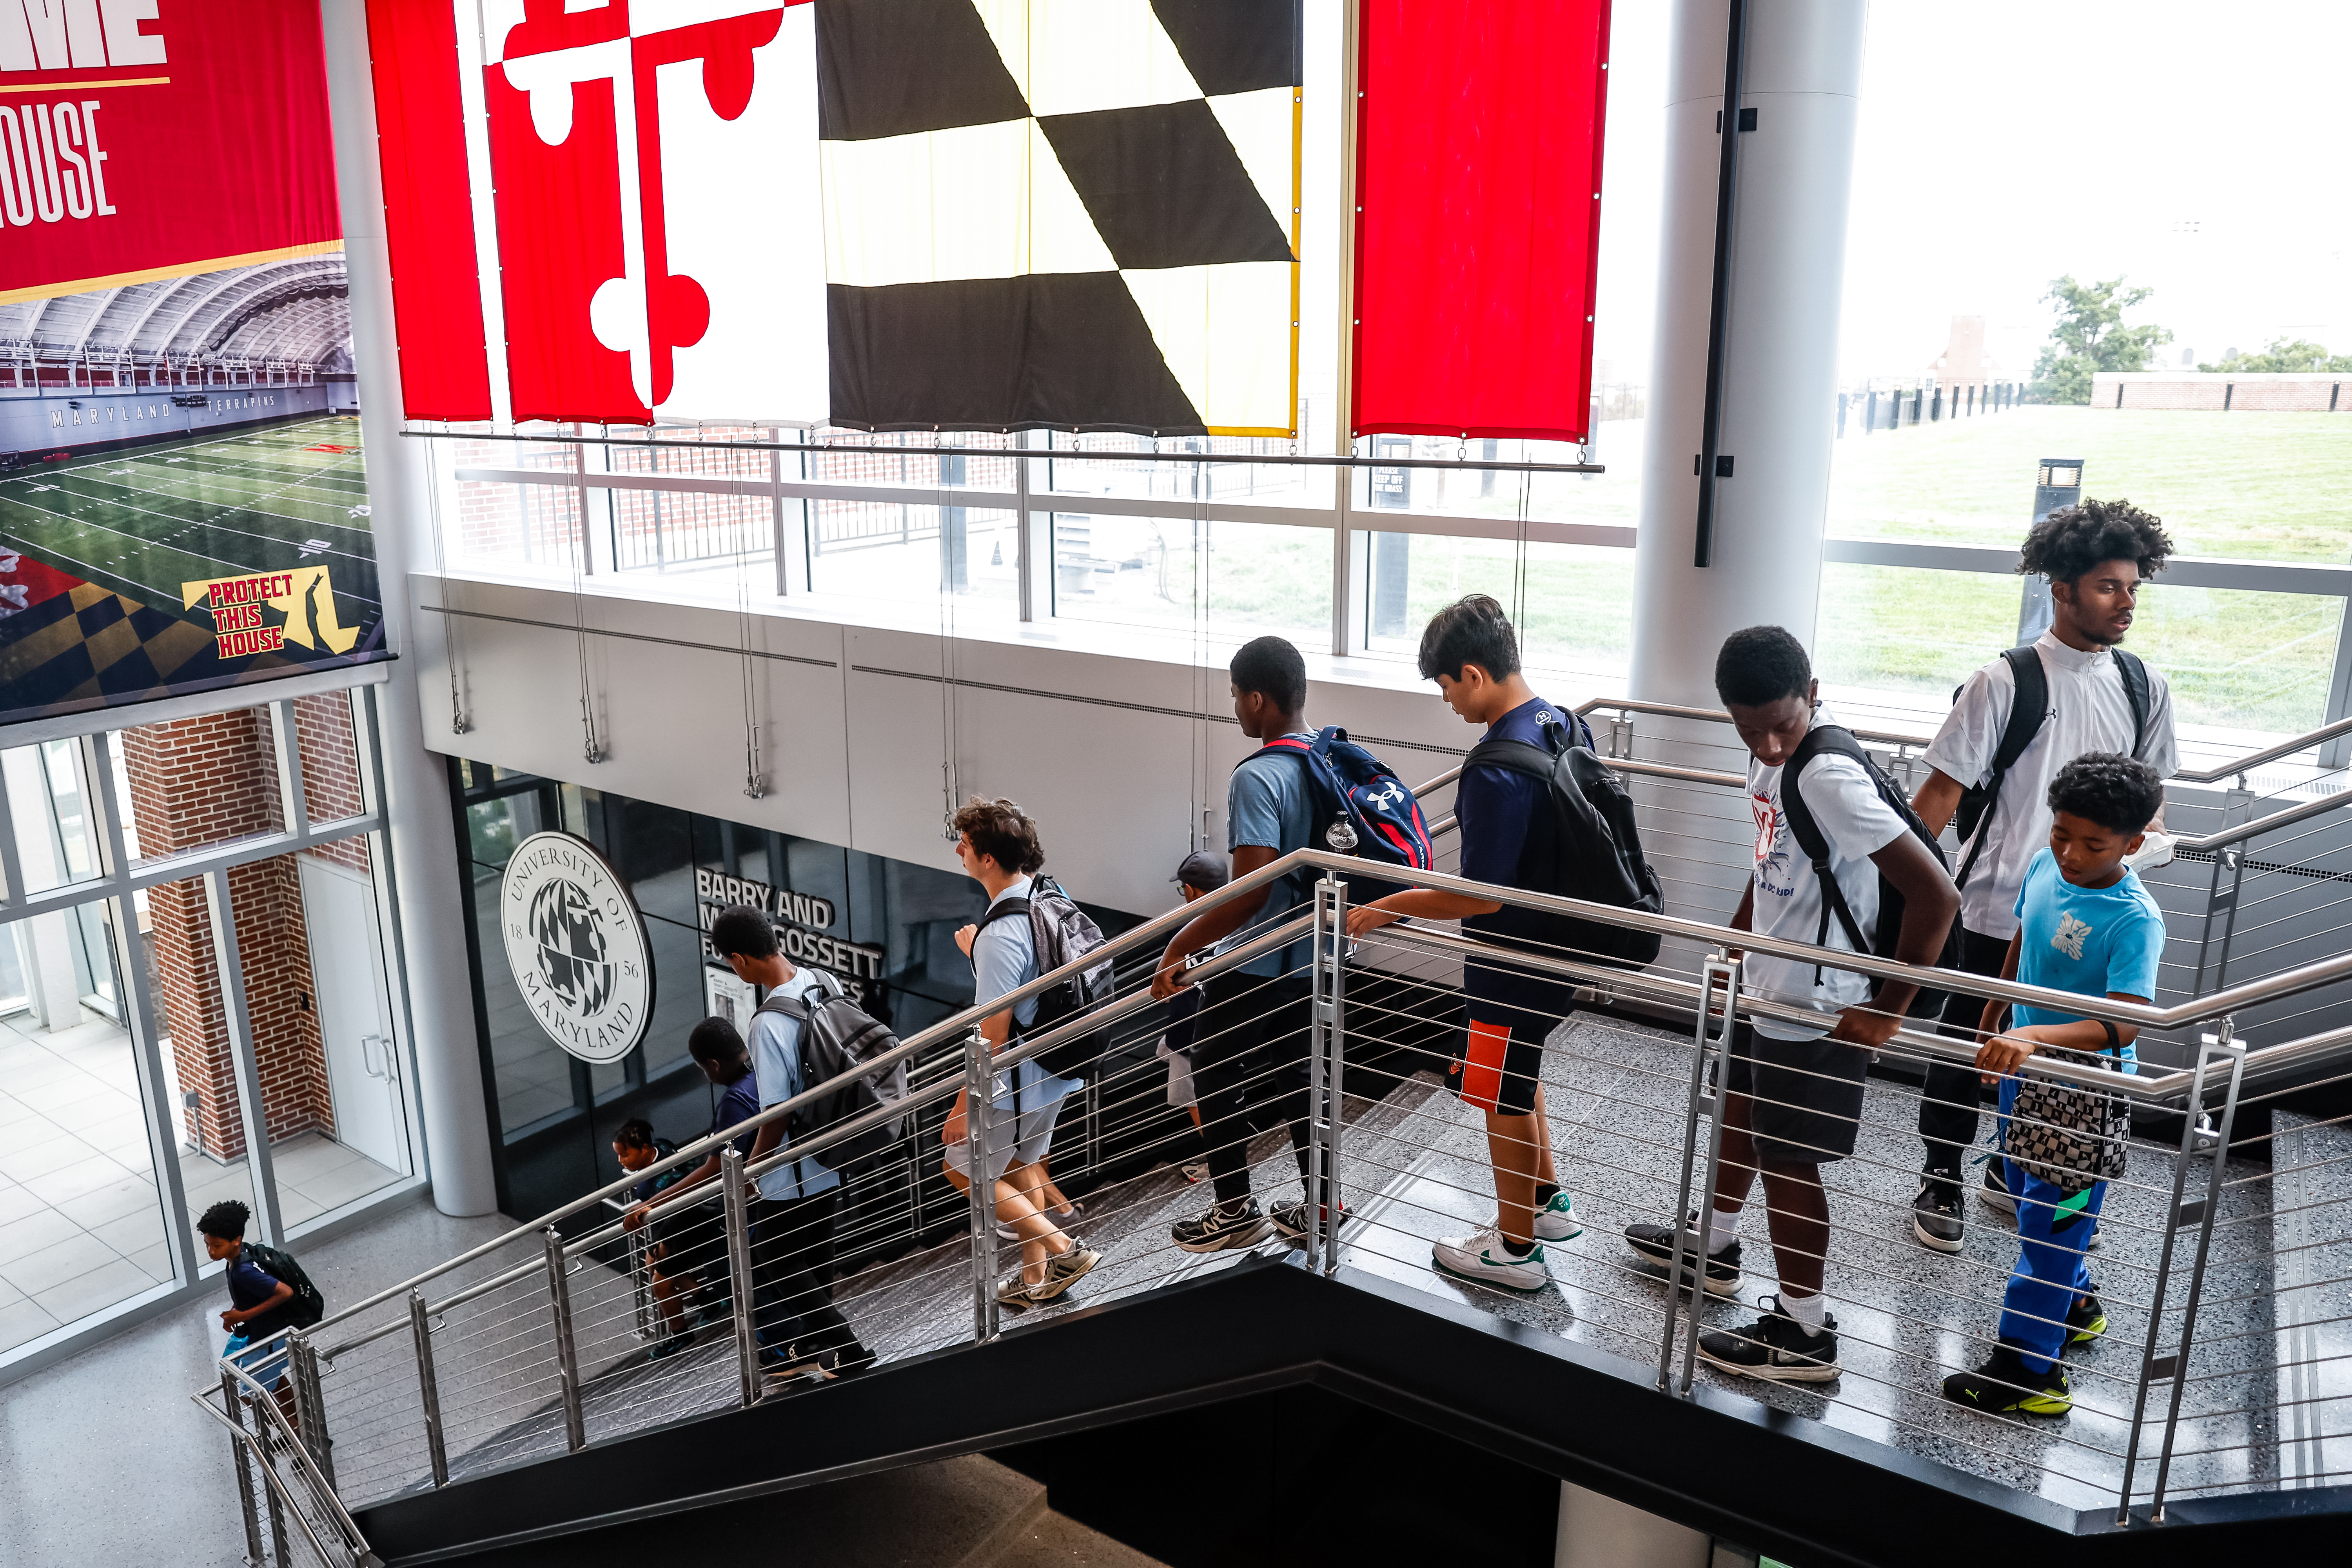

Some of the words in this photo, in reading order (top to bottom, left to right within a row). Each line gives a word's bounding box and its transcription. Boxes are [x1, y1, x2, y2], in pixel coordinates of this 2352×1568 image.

[0, 100, 117, 228] OUSE
[51, 403, 170, 428] MARYLAND
[207, 395, 275, 412] TERRAPINS
[1391, 475, 1404, 485] OFF
[208, 573, 292, 607] PROTECT
[213, 604, 262, 632] THIS
[217, 626, 283, 658] HOUSE
[512, 848, 603, 901] UNIVERSITY
[607, 898, 628, 931] OF
[697, 868, 771, 913] BARRY
[777, 891, 829, 930] AND
[510, 924, 523, 940] 18
[772, 924, 882, 980] GOSSETT
[624, 960, 639, 979] 56
[523, 971, 633, 1048] MARYLAND
